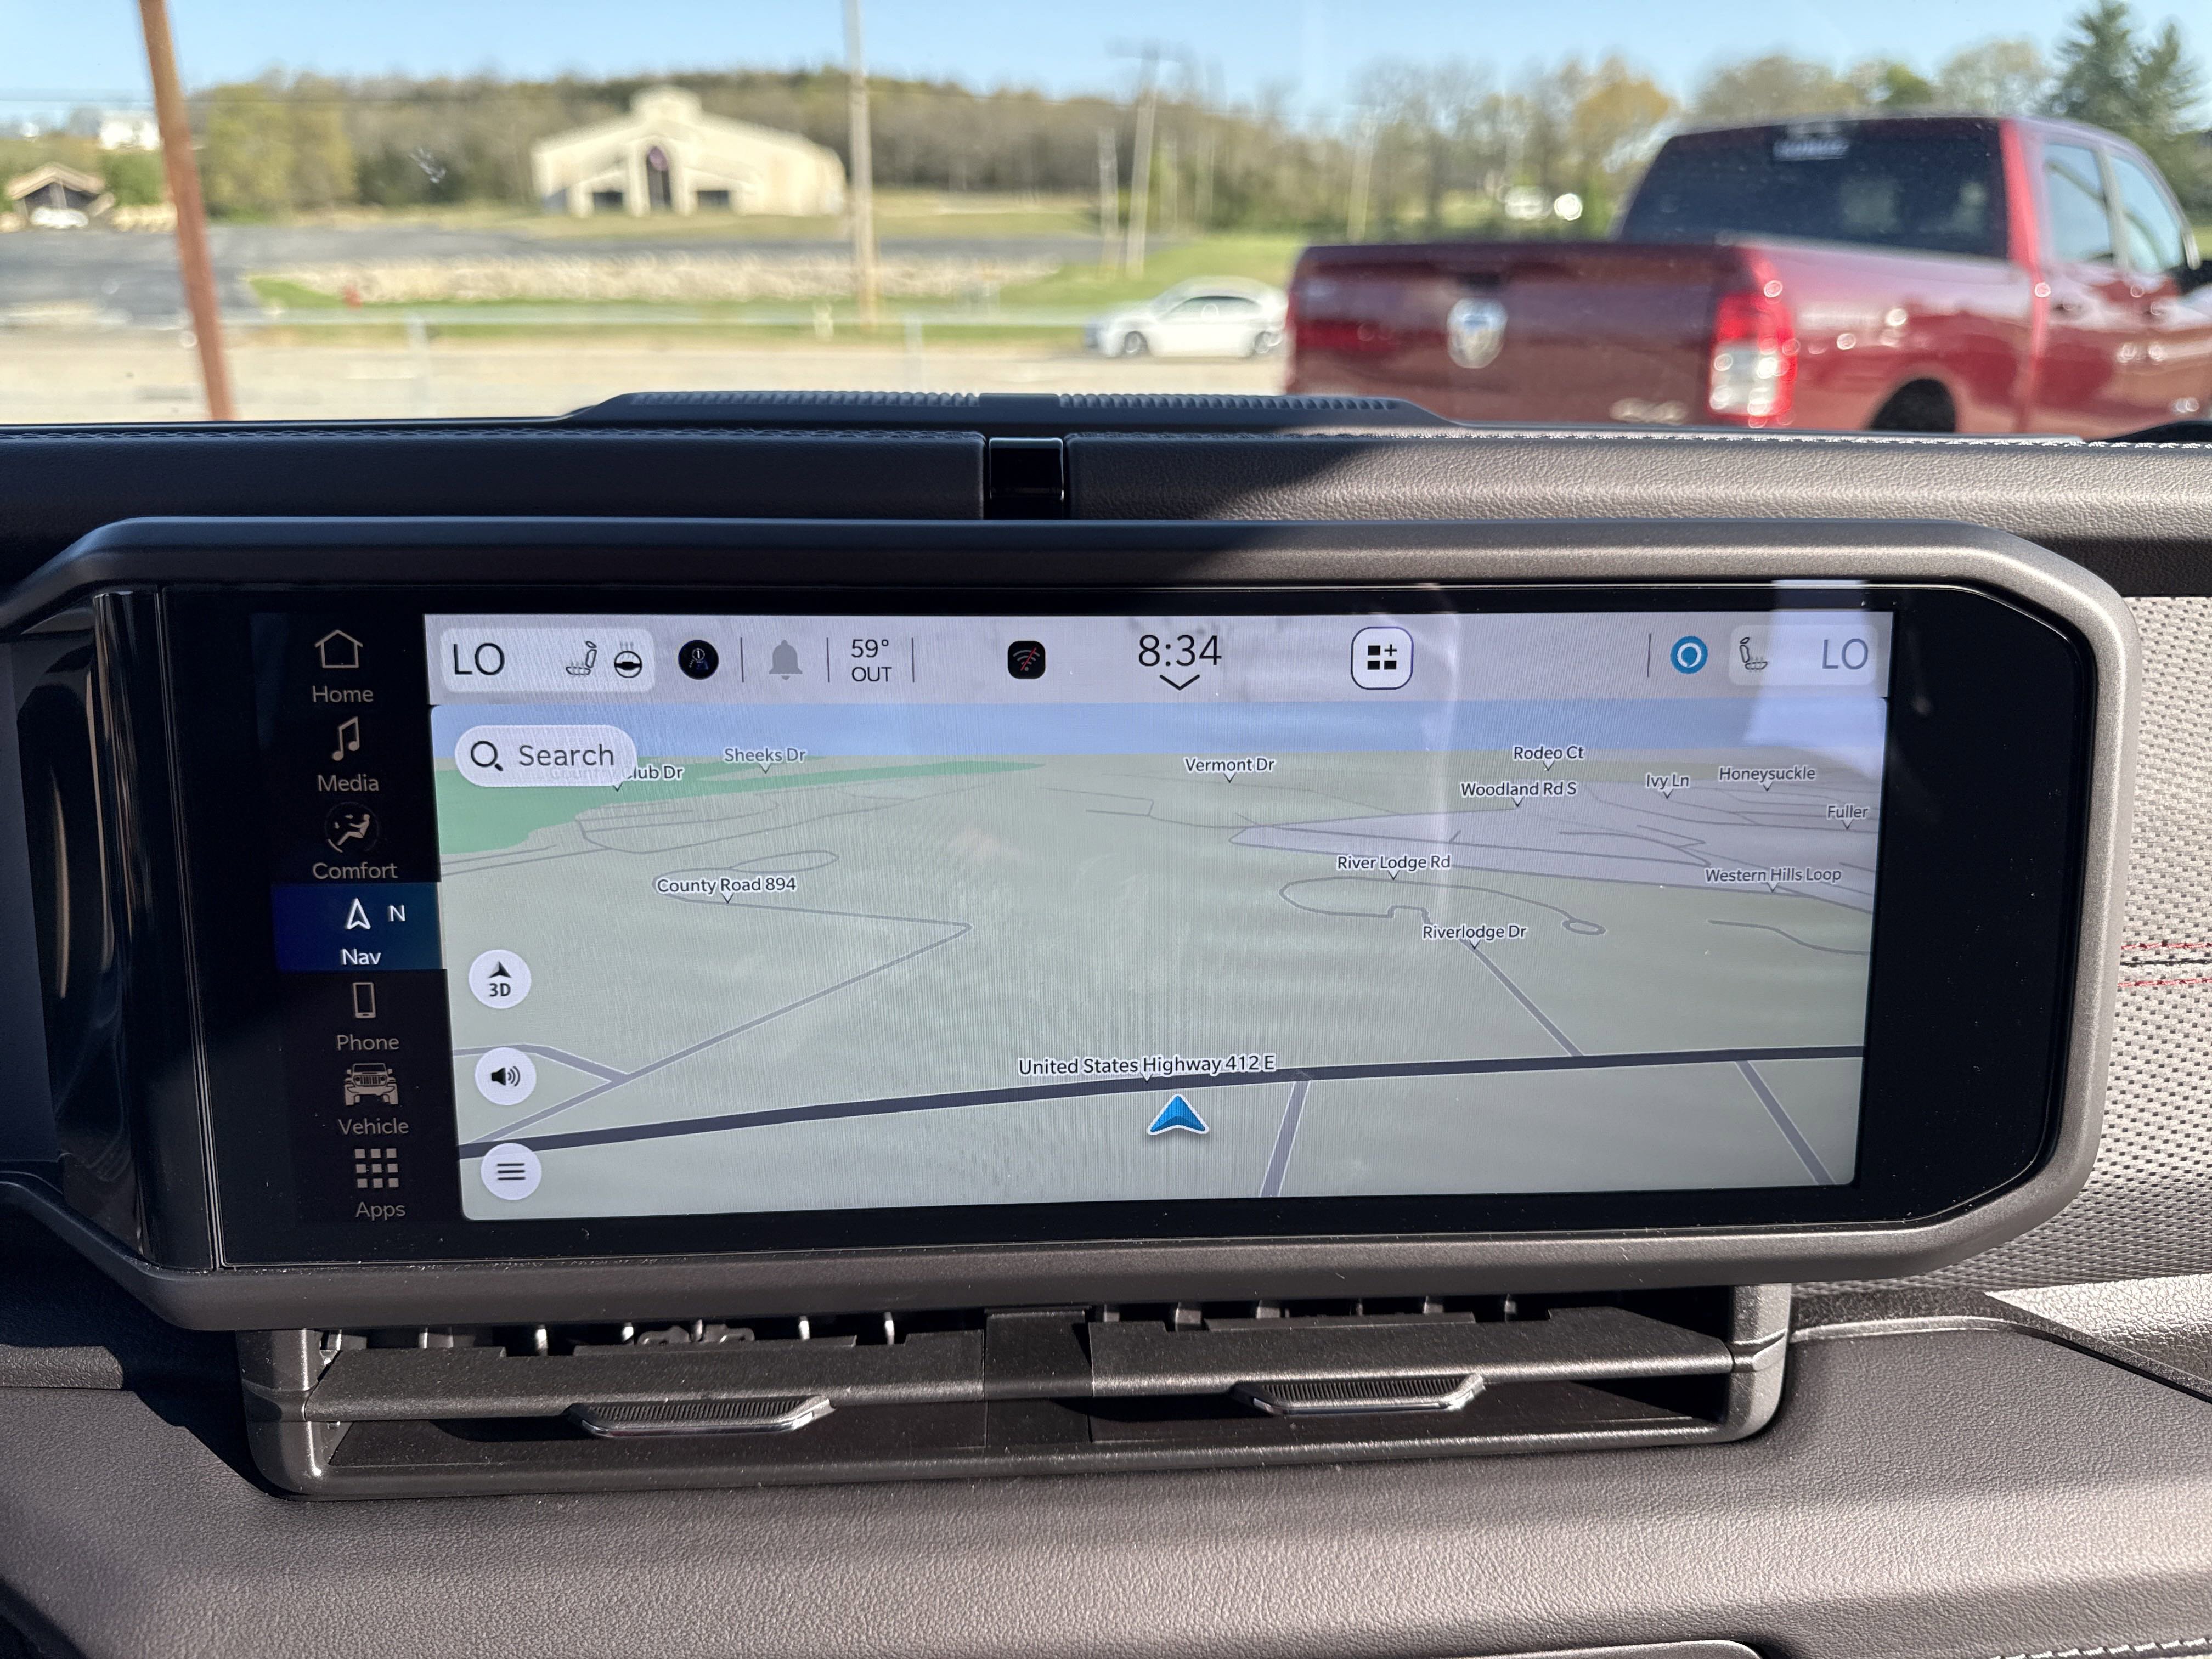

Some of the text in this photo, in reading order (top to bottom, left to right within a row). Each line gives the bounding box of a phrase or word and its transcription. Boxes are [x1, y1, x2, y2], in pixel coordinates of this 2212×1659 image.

[851, 639, 889, 658] 59°
[1138, 635, 1222, 667] 8:34
[1823, 639, 1867, 670] LO
[453, 642, 505, 675] LO
[851, 667, 892, 682] OUT
[312, 686, 374, 703] Home
[520, 744, 614, 766] Search
[724, 748, 806, 763] Sheeks Dr
[1514, 747, 1584, 760] Rodeo Ct
[664, 766, 683, 779] Dr
[1185, 758, 1276, 771] Vermont Dr
[318, 775, 379, 792] Media
[1646, 774, 1689, 791] Ivy Ln
[1719, 767, 1815, 784] Honeysuckle
[1462, 782, 1576, 797] Woodland Rd S
[1828, 805, 1867, 819] Fuller
[313, 862, 398, 879] Comfort
[1338, 855, 1451, 872] River Lodge Rd
[1706, 868, 1842, 884] Western Hills Loop
[658, 877, 797, 895] County Road 894
[390, 905, 405, 922] N
[1423, 925, 1526, 940] Riverlodge Dr
[342, 949, 381, 965] Nav
[489, 983, 511, 997] 3D
[337, 1034, 399, 1051] Phone
[1019, 1056, 1275, 1075] United States Highway 412 E
[338, 1119, 409, 1135] Vehicle
[356, 1203, 405, 1221] Apps
